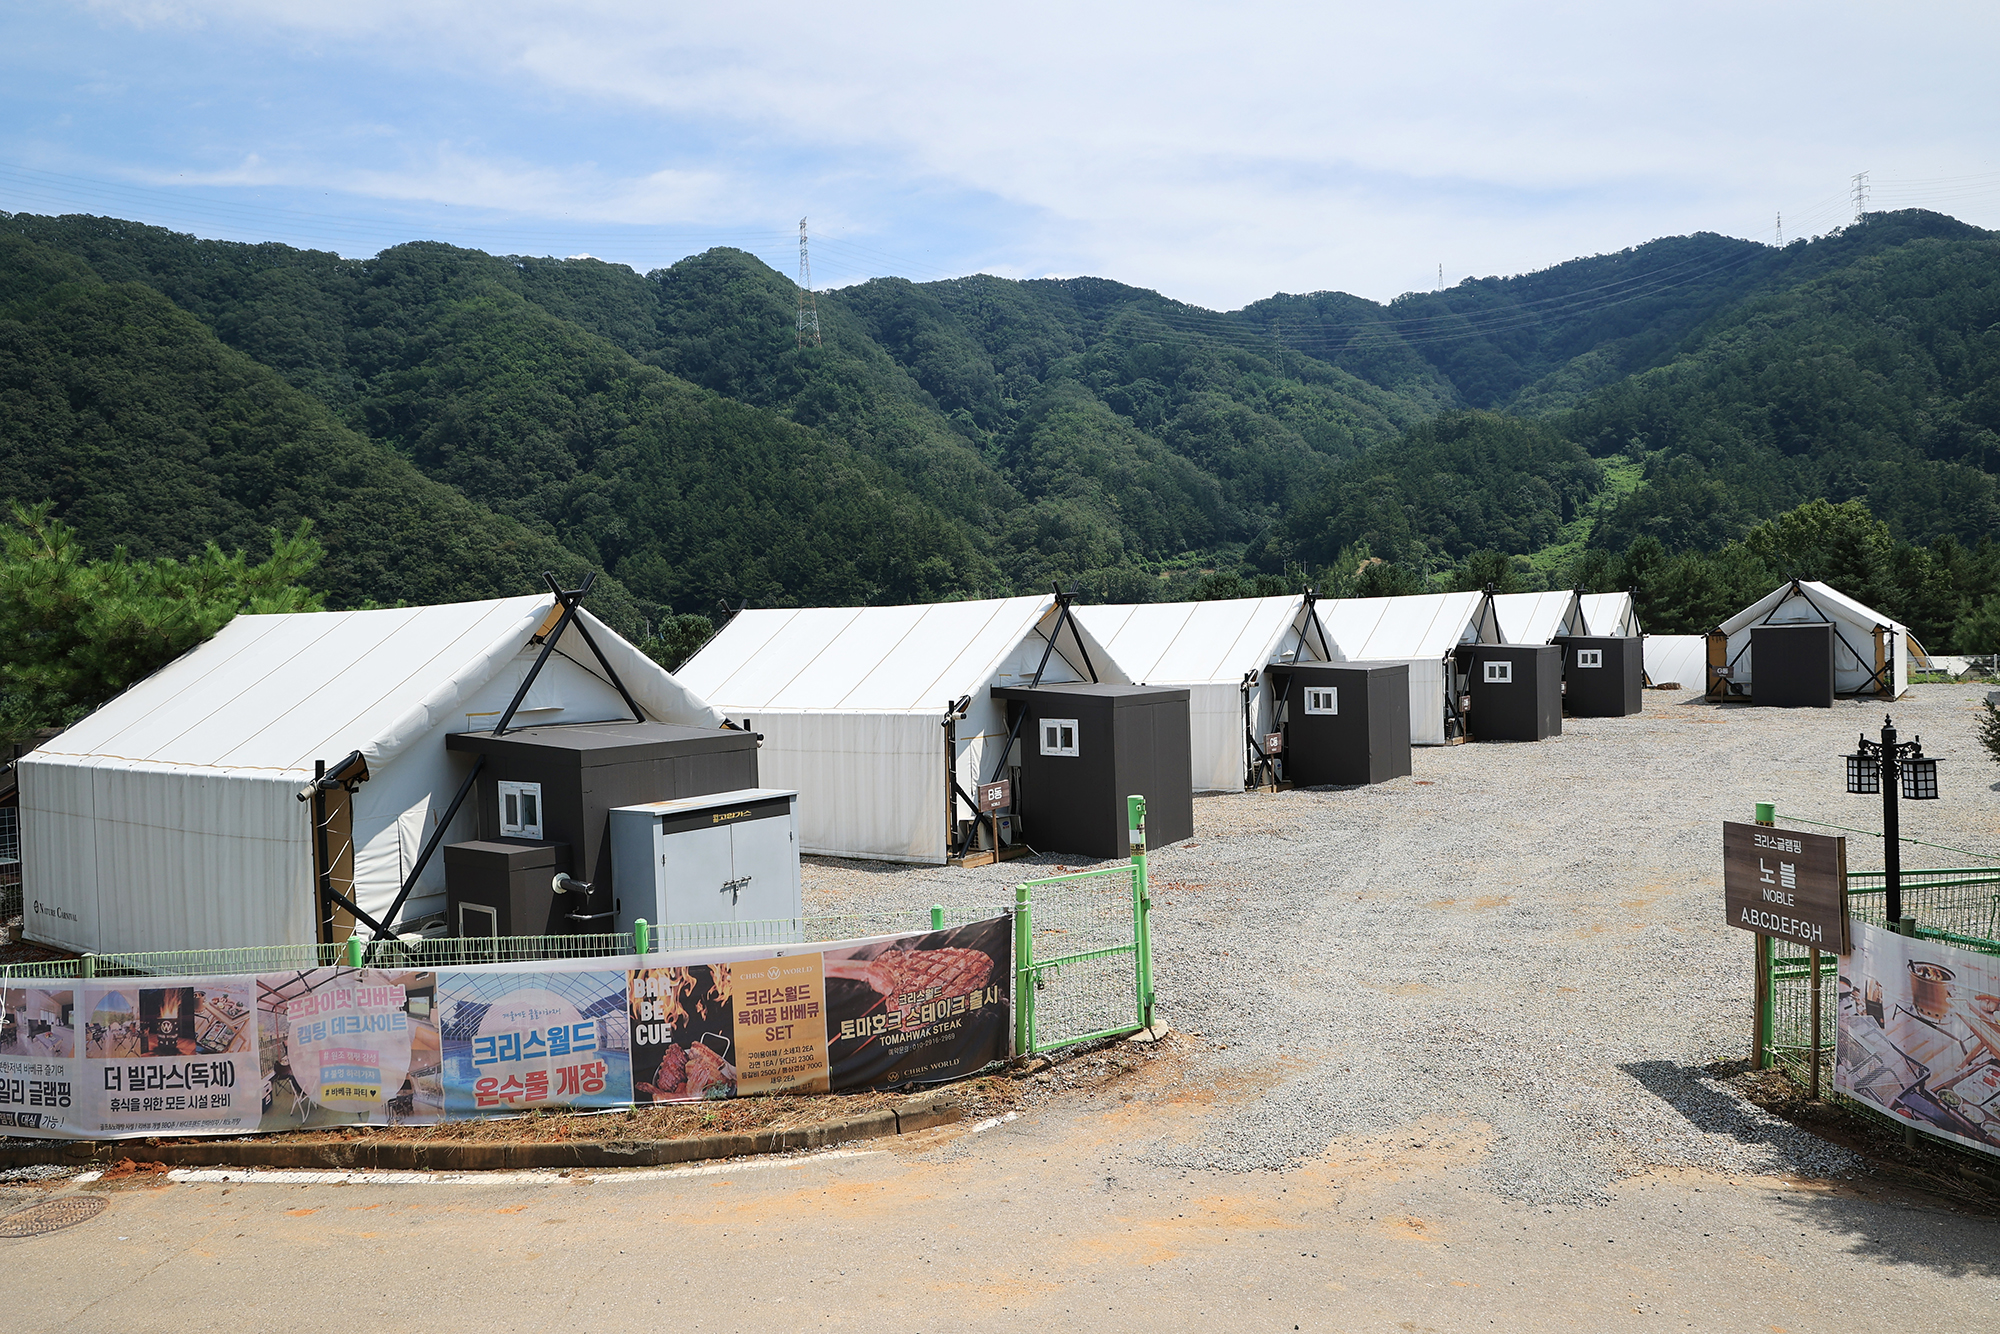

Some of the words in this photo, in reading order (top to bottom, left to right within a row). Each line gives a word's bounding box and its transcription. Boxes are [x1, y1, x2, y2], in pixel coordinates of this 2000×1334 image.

[988, 787, 1003, 801] B동
[1754, 834, 1802, 854] 크리스글램핑
[1762, 888, 1795, 907] NOBLE
[740, 972, 765, 980] CHRIS
[783, 966, 813, 975] WORLD
[634, 977, 672, 998] BAR
[745, 984, 811, 1006] 크리스월드
[899, 986, 943, 1006] 크리스월드
[288, 989, 352, 1021] 프라이빗
[357, 985, 405, 1008] 리버뷰
[641, 1001, 664, 1021] BE
[840, 1011, 902, 1040] 토마호크
[906, 994, 966, 1026] 스테이크
[969, 985, 998, 1010] 출시
[738, 1007, 777, 1026] 육해공
[780, 1001, 819, 1021] 바베큐
[331, 1013, 407, 1036] 데크사이트
[636, 1023, 672, 1046] CUE
[765, 1024, 794, 1042] SET
[880, 1029, 932, 1047] TOMAHWAK
[933, 1019, 962, 1035] STEAK
[474, 1021, 597, 1066] 크리스월드
[784, 1046, 801, 1055] 소세지
[802, 1045, 814, 1053] 2EA
[45, 1064, 64, 1077] 즐기며
[749, 1060, 761, 1069] 라면
[799, 1055, 814, 1063] 230G
[807, 1062, 823, 1070] 700G
[904, 1065, 928, 1076] CHRIS
[930, 1058, 960, 1070] WORLD
[104, 1065, 121, 1091] 더
[128, 1060, 235, 1091] 빌라스(독채)
[475, 1070, 549, 1107] 온수풀
[556, 1062, 606, 1096] 개장
[29, 1081, 72, 1108] 글램핑
[110, 1098, 140, 1112] 휴식을
[143, 1097, 163, 1111] 위한
[165, 1096, 185, 1110] 모든
[188, 1095, 208, 1109] 시설
[211, 1093, 230, 1108] 완비
[331, 1087, 352, 1097] 바베큐
[353, 1088, 368, 1098] 파티
[21, 1114, 38, 1128] 대실
